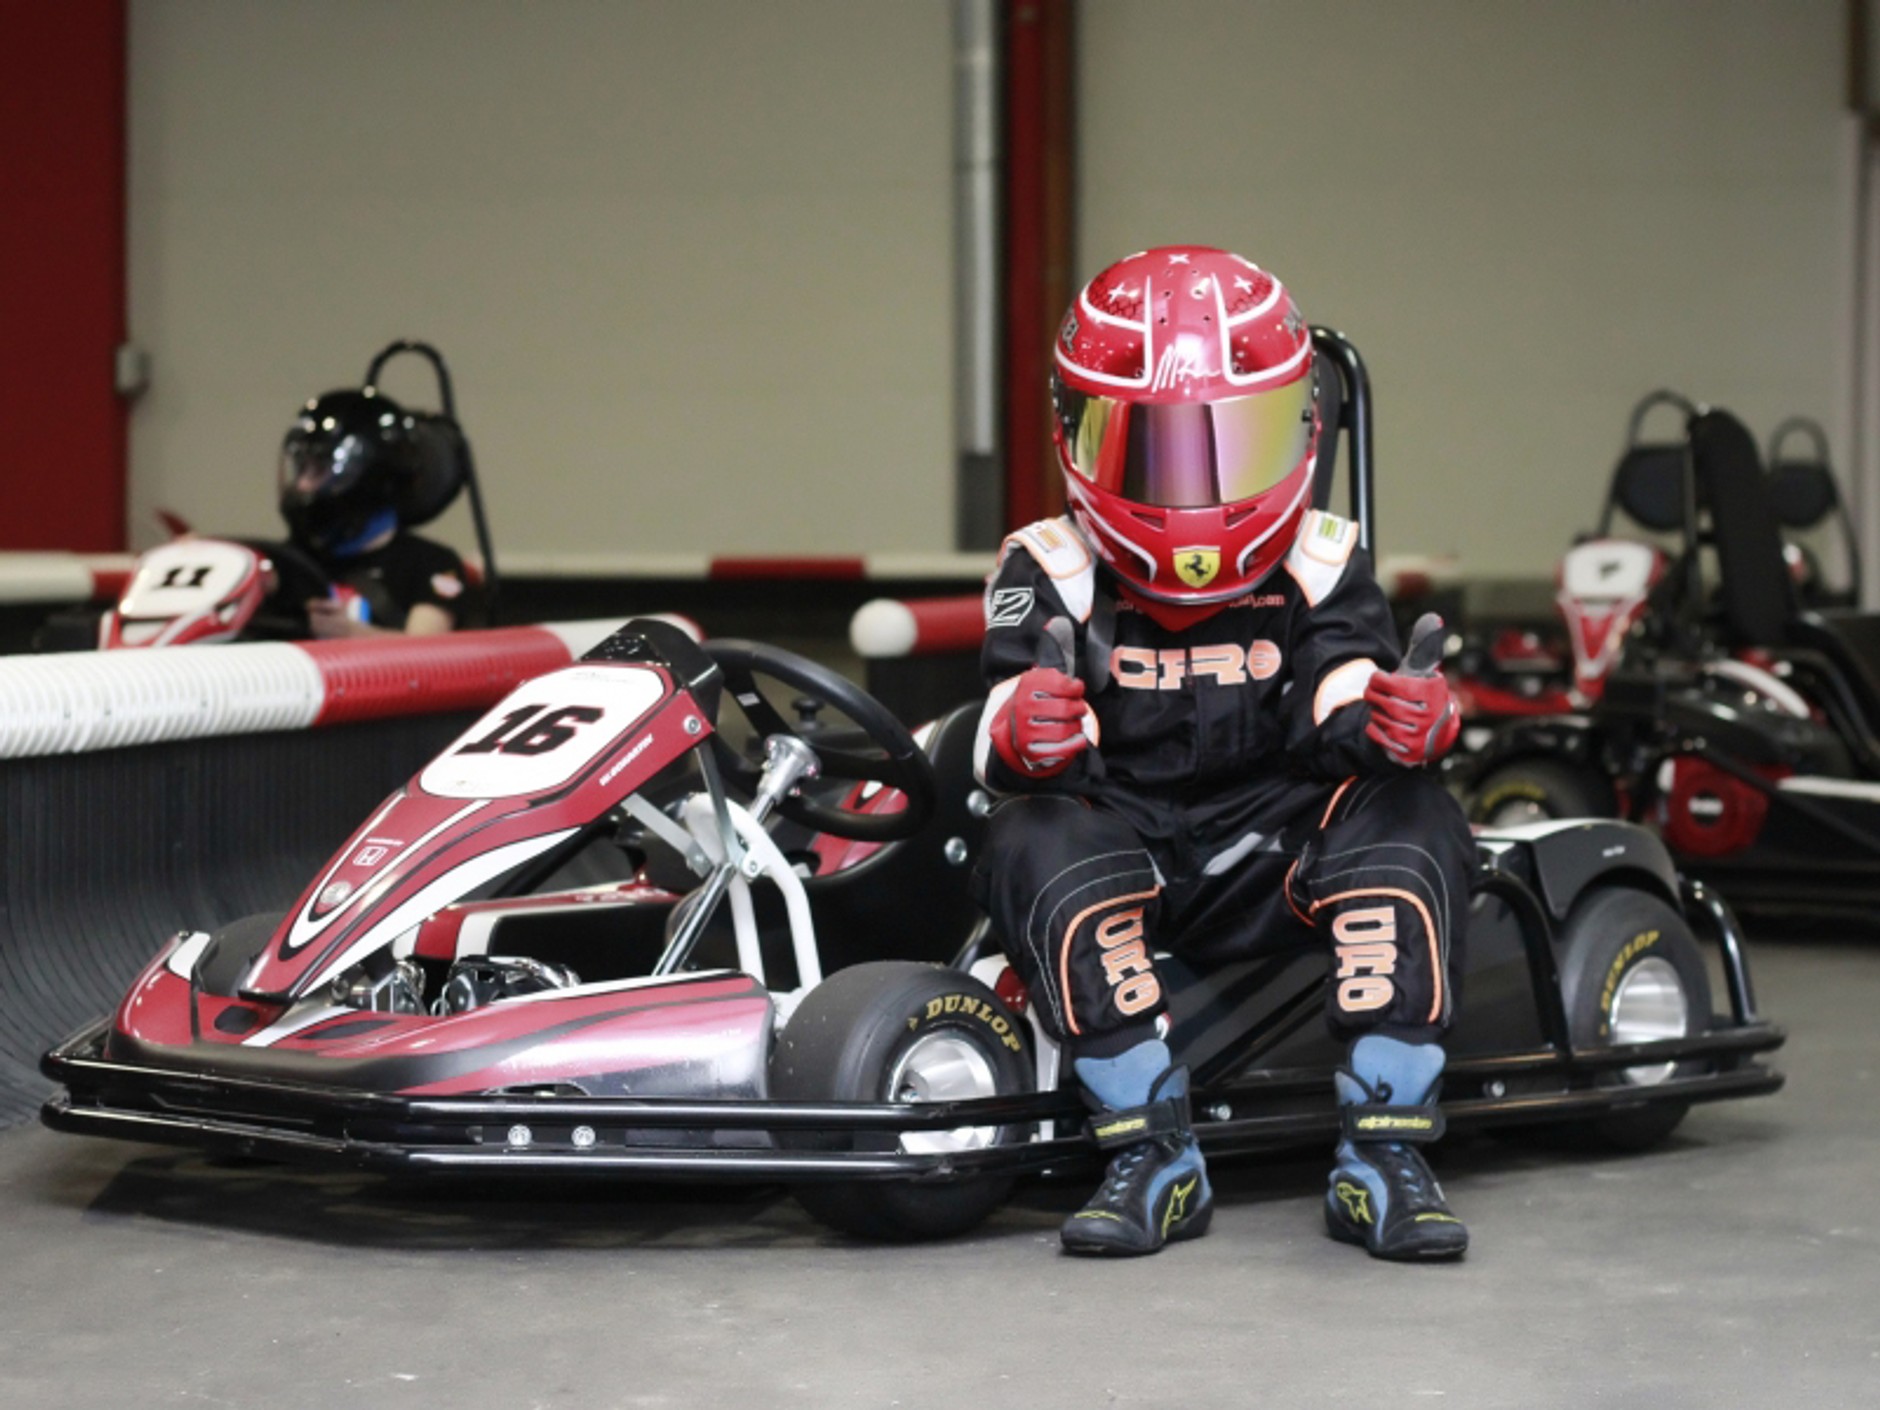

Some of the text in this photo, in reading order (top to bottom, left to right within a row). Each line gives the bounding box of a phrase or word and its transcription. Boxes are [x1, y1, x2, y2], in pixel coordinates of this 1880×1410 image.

[452, 704, 605, 757] 16
[1601, 930, 1660, 1013] DUNLOP
[926, 994, 1021, 1052] DUNLOP
